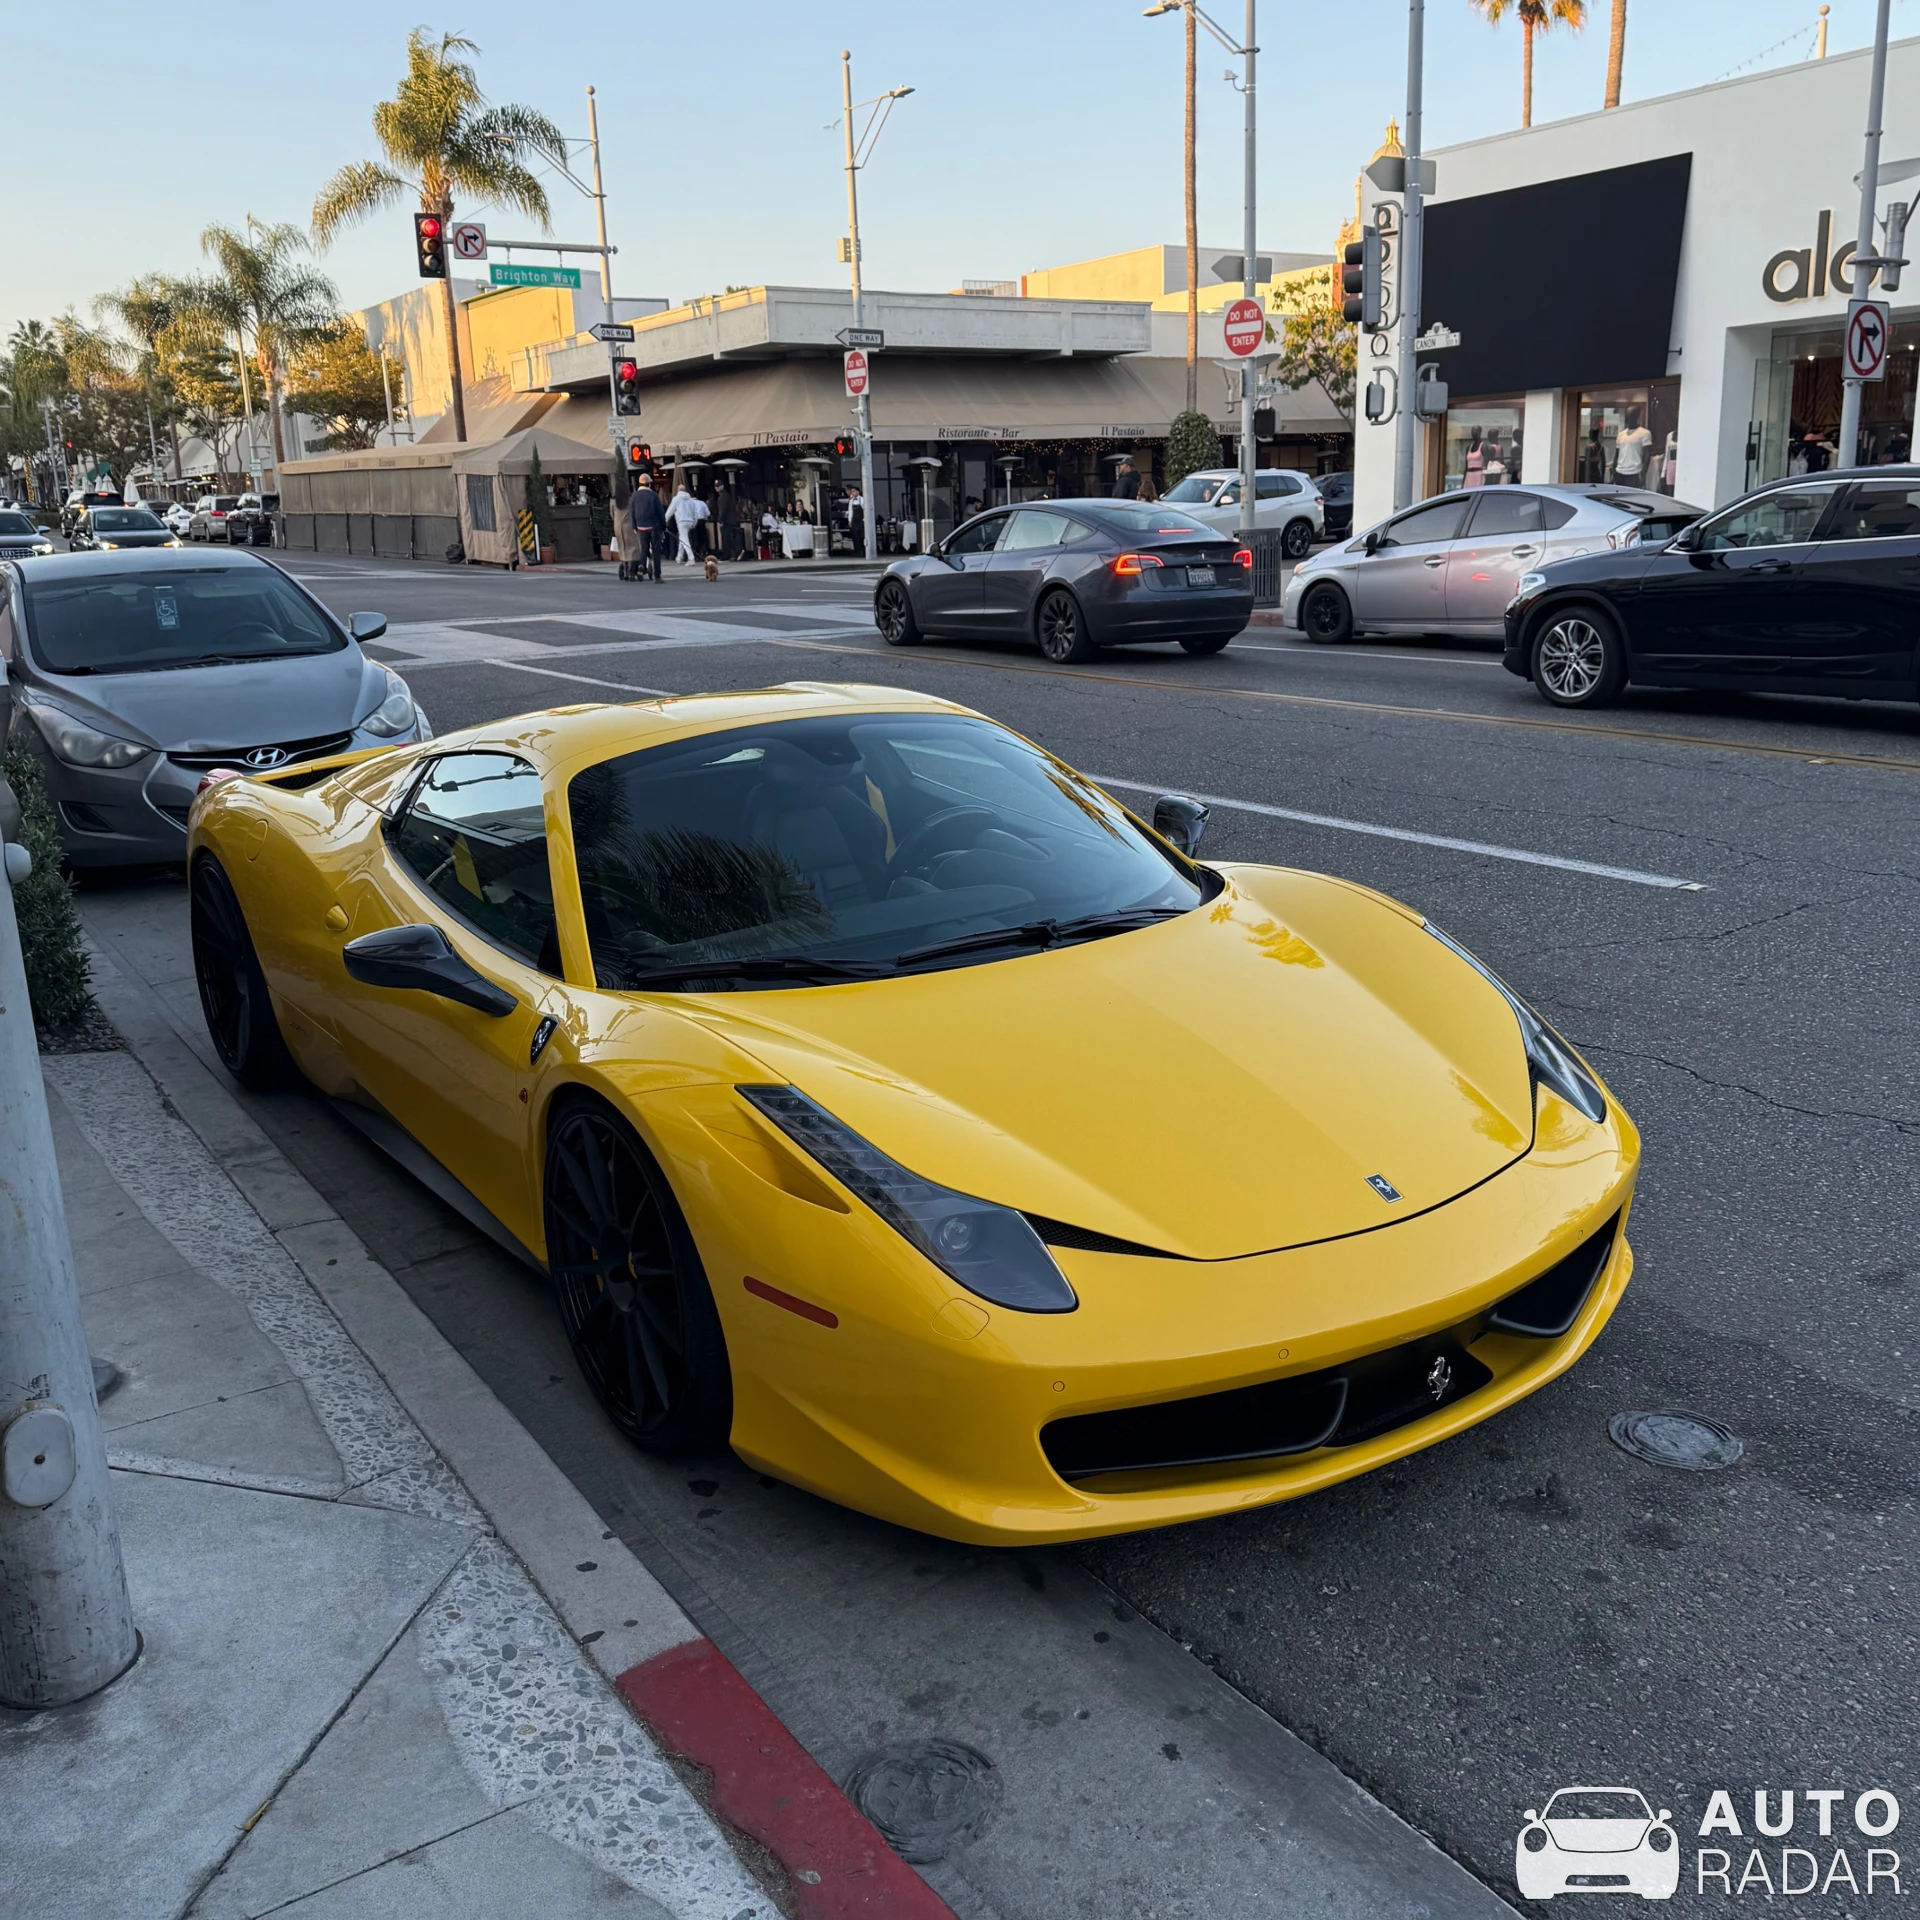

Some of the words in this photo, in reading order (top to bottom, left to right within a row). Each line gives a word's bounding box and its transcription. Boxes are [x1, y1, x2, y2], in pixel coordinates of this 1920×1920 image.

[1762, 209, 1880, 303] alo
[495, 268, 547, 285] Brighton
[553, 271, 576, 287] Way
[1230, 310, 1241, 321] DO
[1243, 308, 1258, 320] NOT
[601, 328, 615, 336] ONE
[849, 333, 863, 341] ONE
[865, 334, 879, 342] WAY
[1232, 334, 1255, 347] ENTER
[1415, 337, 1436, 350] CANON
[938, 427, 990, 438] Ristorante
[1001, 427, 1020, 438] Bar
[1101, 426, 1109, 436] Il
[1112, 425, 1145, 436] Pastaio
[753, 432, 761, 445] Il
[765, 430, 808, 444] Pastaio
[643, 448, 650, 460] 4
